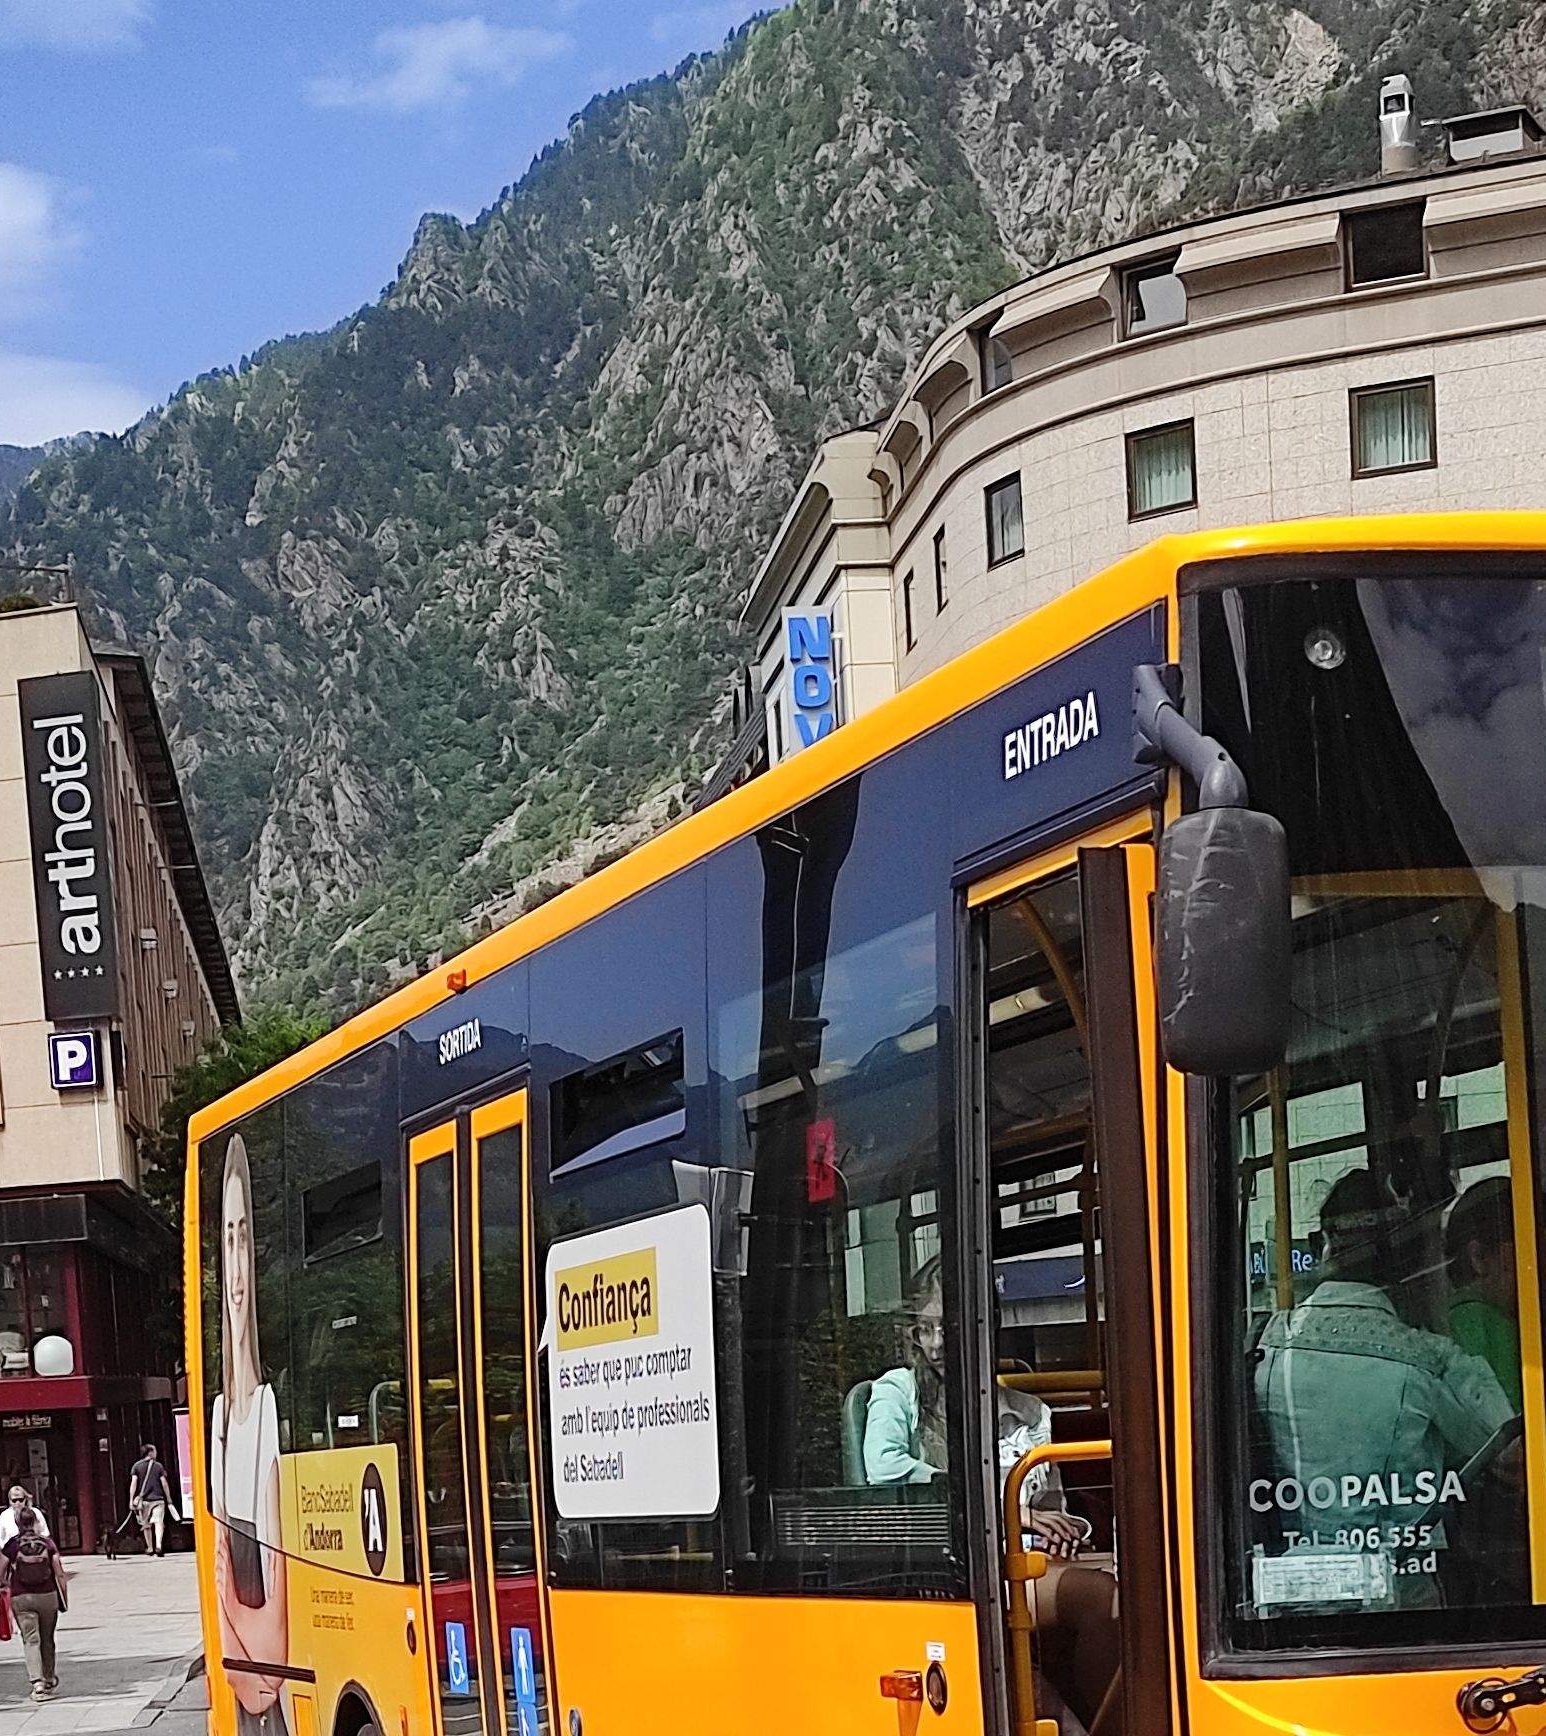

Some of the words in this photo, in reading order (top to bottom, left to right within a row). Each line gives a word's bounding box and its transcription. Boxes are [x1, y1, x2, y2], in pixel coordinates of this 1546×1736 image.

[1005, 691, 1099, 780] ENTRADA
[32, 713, 102, 956] arthotel
[56, 1040, 88, 1081] P
[439, 1018, 481, 1065] SORTIDA
[558, 1273, 651, 1334] Confiança
[559, 1359, 571, 1388] és
[573, 1358, 600, 1387] saber
[603, 1357, 622, 1390] que
[646, 1344, 692, 1379] comptar
[562, 1406, 584, 1435] amb
[621, 1400, 635, 1429] de
[637, 1391, 710, 1438] professionals
[564, 1454, 579, 1482] del
[1249, 1470, 1467, 1513] COOPALSA
[1388, 1524, 1433, 1548] 555
